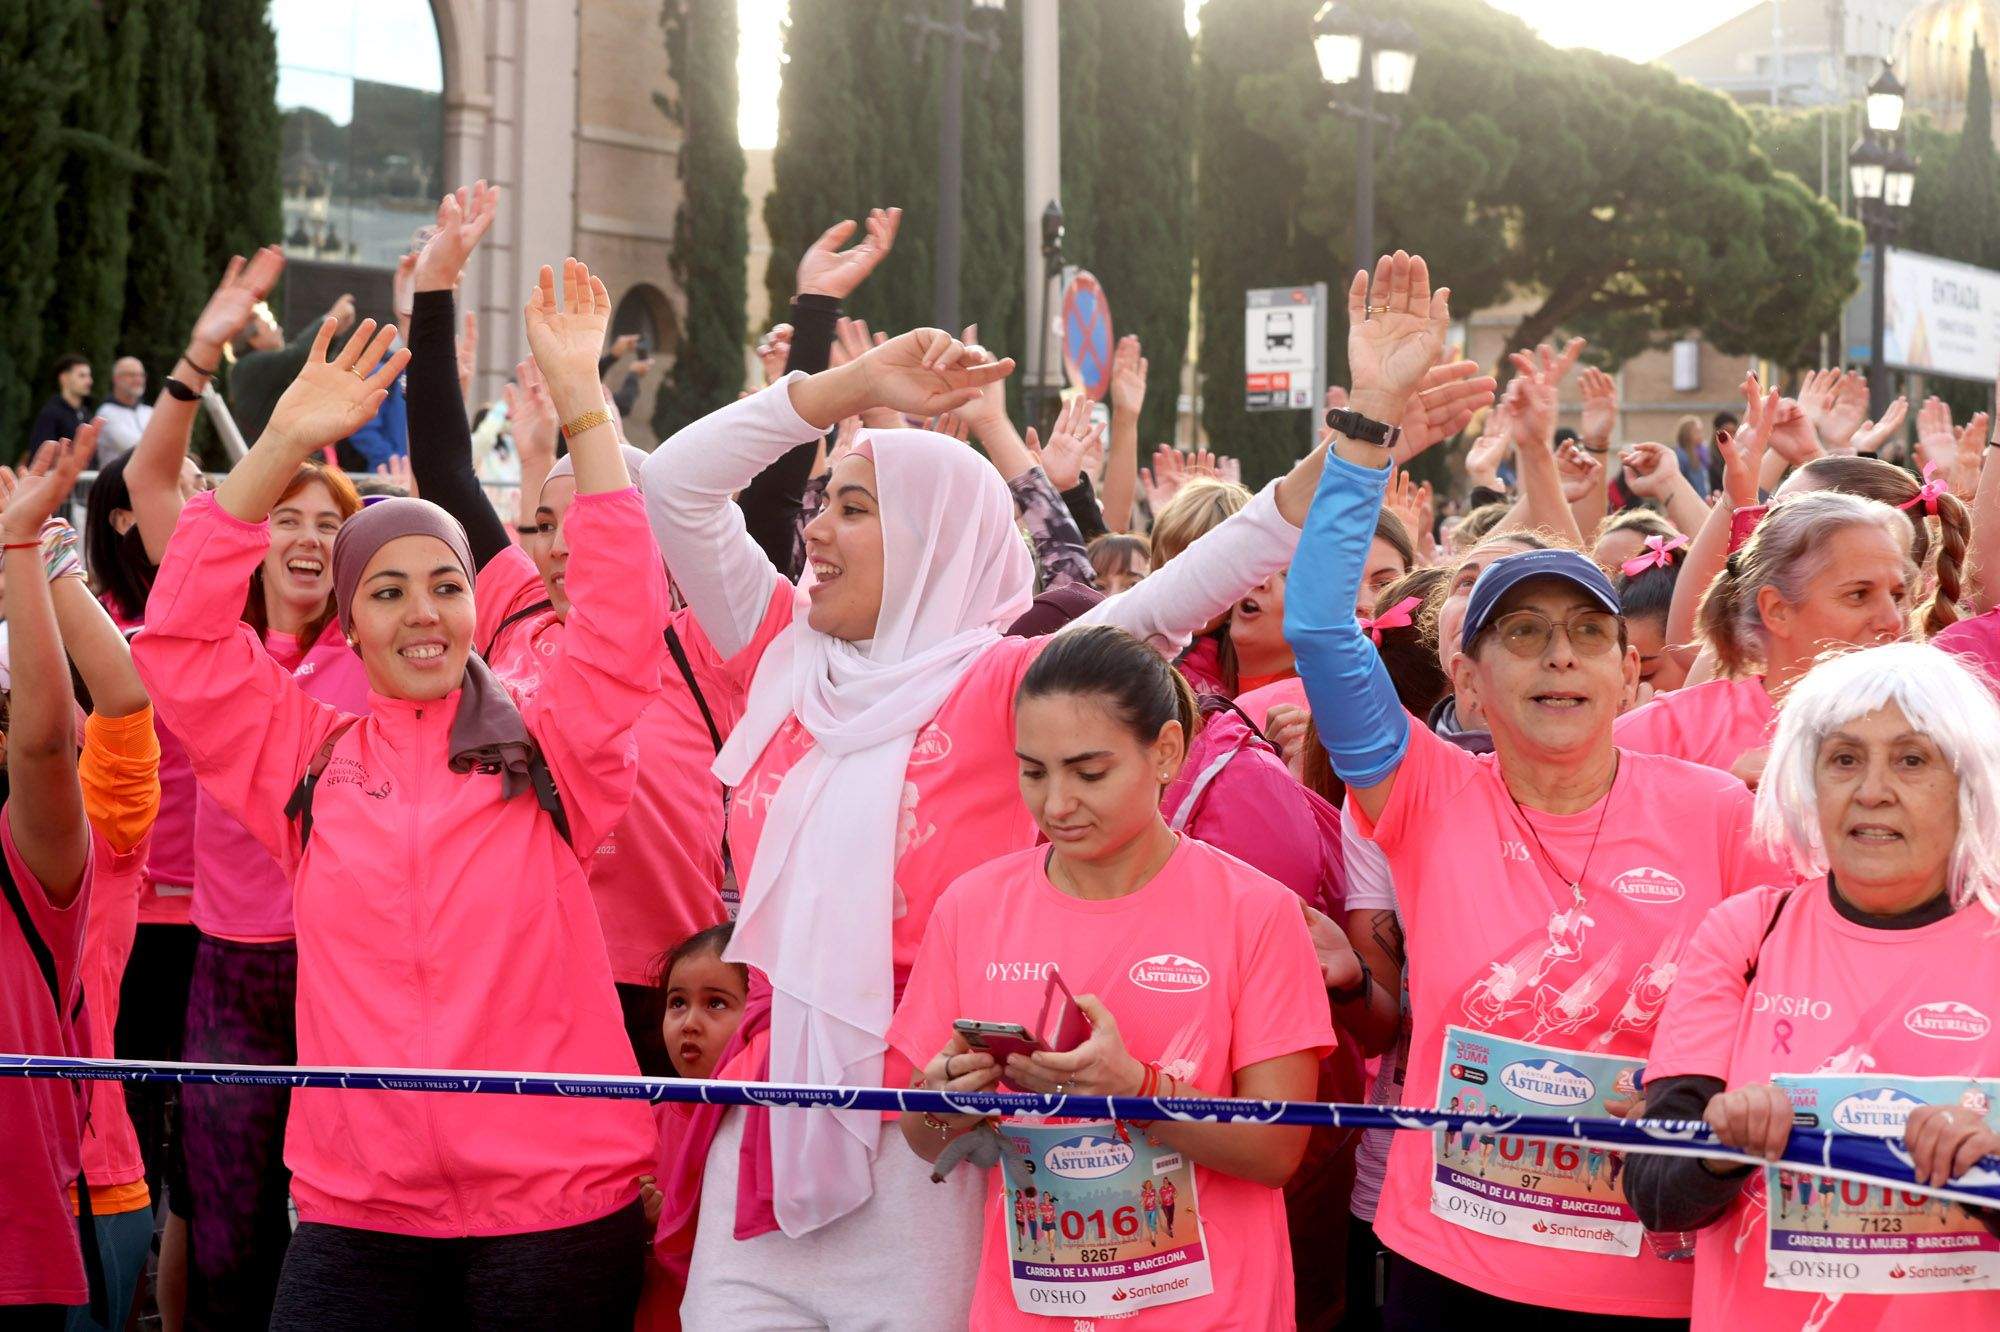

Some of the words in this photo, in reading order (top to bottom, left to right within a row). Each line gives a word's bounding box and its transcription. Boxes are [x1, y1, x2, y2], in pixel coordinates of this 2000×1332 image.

[327, 775, 363, 788] SEVILLA
[1616, 879, 1680, 897] ASTURIANA
[1135, 966, 1204, 985] ASTURIANA
[1910, 1010, 1985, 1034] ASTURIANA
[1456, 1049, 1488, 1066] SUMA
[388, 1080, 423, 1088] LECHERA
[424, 1080, 459, 1089] CENTRAL
[565, 1084, 602, 1094] LECHERA
[603, 1085, 640, 1095] CENTRAL
[1505, 1069, 1588, 1099] ASTURIANA
[753, 1090, 792, 1099] LECHERA
[795, 1091, 833, 1100] CENTRAL
[997, 1097, 1039, 1106] CENTRAL
[1049, 1152, 1130, 1170] ASTURIANA
[1499, 1137, 1580, 1171] 016
[1521, 1174, 1541, 1189] 97
[1450, 1172, 1487, 1195] CARRERA
[1489, 1185, 1502, 1197] DE
[1504, 1188, 1516, 1201] LA
[1519, 1190, 1553, 1207] MUJER
[1561, 1199, 1621, 1216] BARCELONA
[1449, 1195, 1506, 1226] OYSHO
[1060, 1205, 1139, 1240] 016
[1860, 1217, 1903, 1233] 7123
[1549, 1222, 1615, 1242] Santander
[1788, 1234, 1833, 1248] CARRERA
[1835, 1236, 1850, 1249] DE
[1852, 1236, 1867, 1249] LA
[1869, 1236, 1909, 1249] MUJER
[1916, 1234, 1980, 1248] BARCELONA
[1081, 1247, 1118, 1263] 8267
[1025, 1265, 1061, 1278] CARRERA
[1063, 1267, 1075, 1278] DE
[1077, 1266, 1089, 1278] LA
[1091, 1262, 1126, 1276] MUJER
[1133, 1250, 1187, 1272] BARCELONA
[1789, 1259, 1860, 1280] OYSHO
[1908, 1263, 1978, 1280] Santander
[1029, 1288, 1086, 1305] OYSHO
[1128, 1276, 1190, 1300] Santander
[1074, 1319, 1096, 1332] 2024
